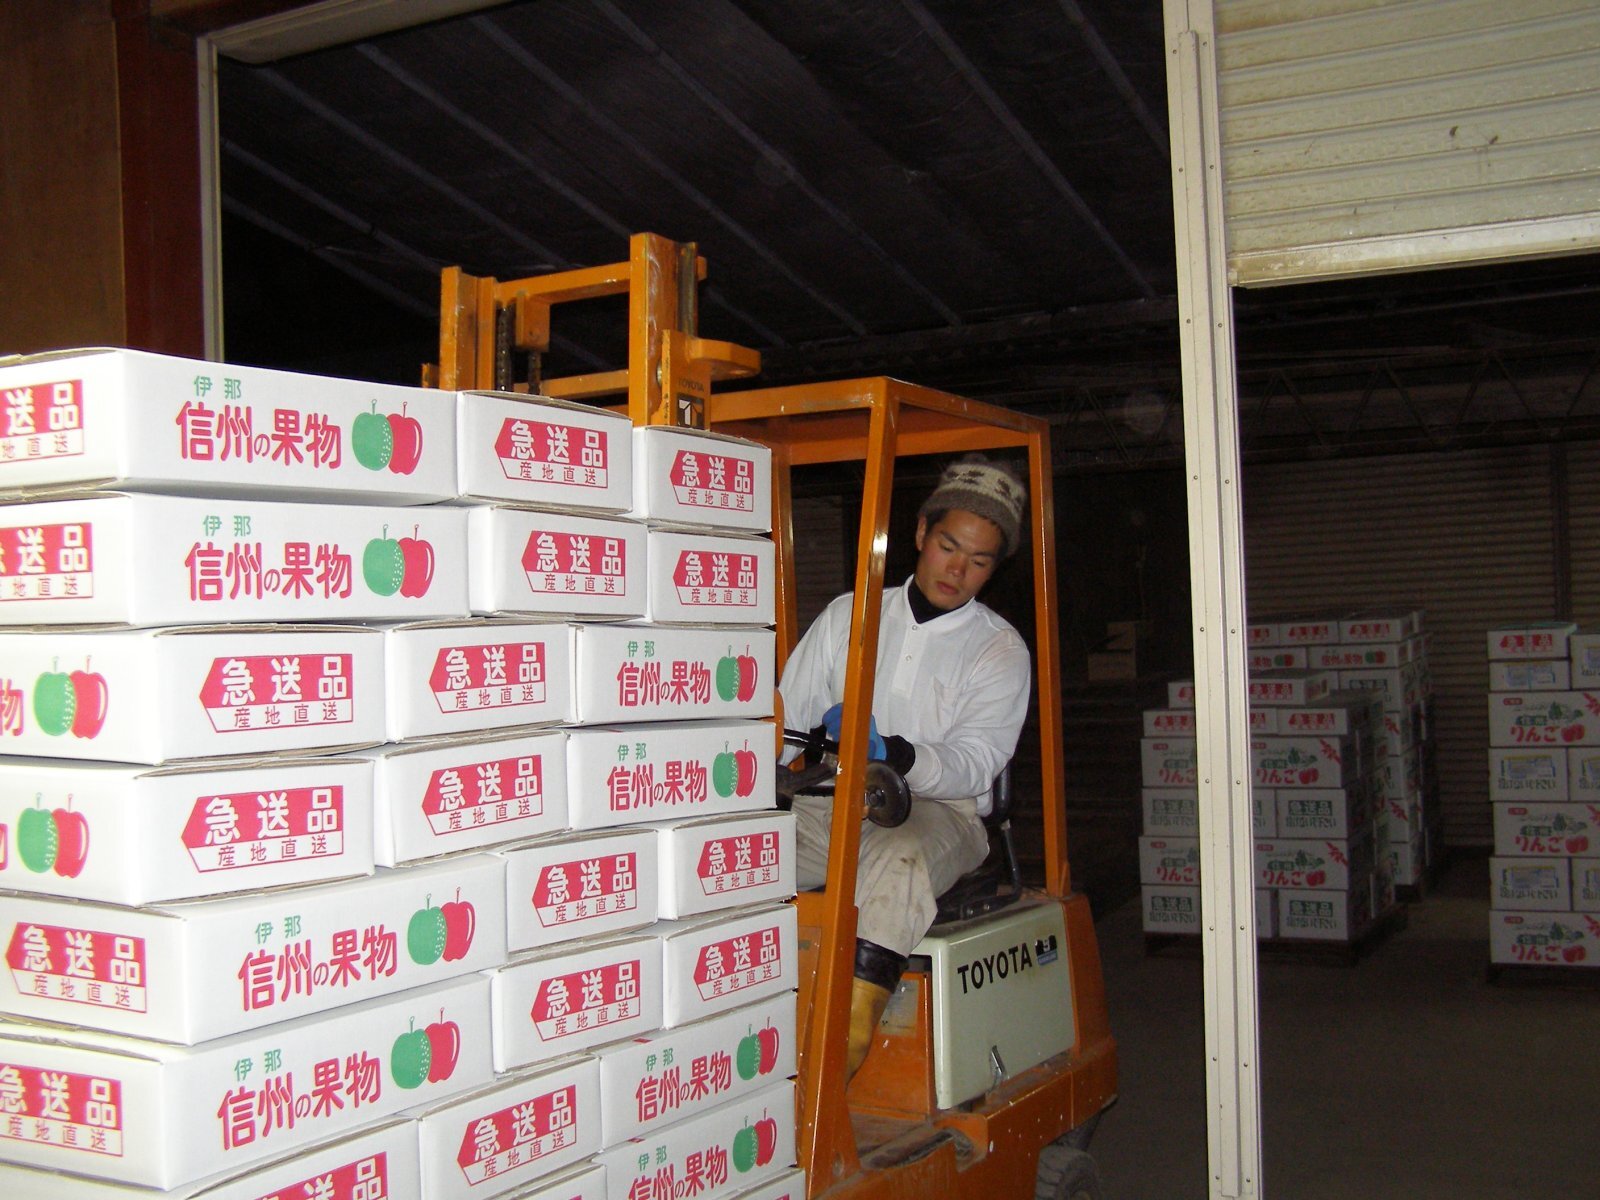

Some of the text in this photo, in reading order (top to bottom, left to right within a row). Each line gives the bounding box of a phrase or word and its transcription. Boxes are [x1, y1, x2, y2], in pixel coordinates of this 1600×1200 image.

[194, 375, 241, 400] 伊那
[176, 400, 341, 469] 信州の果物
[510, 420, 603, 468] 急送品
[520, 461, 597, 485] 産地直送
[681, 453, 751, 493] 急送品
[688, 488, 746, 508] 産地直送
[203, 514, 251, 537] 伊那
[0, 525, 89, 575] 送品
[536, 533, 622, 574] 急送品
[185, 541, 353, 601] 信州の果物
[544, 574, 615, 593] 産地直送
[685, 551, 755, 588] 急送品
[690, 588, 749, 605] 産地直送
[627, 640, 655, 657] 伊那
[222, 655, 347, 706] 急送品
[445, 644, 541, 691] 急送品
[617, 660, 711, 707] 信州の果物
[455, 684, 534, 709] 産地直送
[234, 702, 339, 729] 産地直送
[617, 743, 647, 762] 伊那
[439, 757, 538, 812] 急送品
[606, 760, 708, 811] 信州の果物
[1256, 768, 1298, 785] りんご
[205, 788, 338, 845] 急送品
[449, 800, 531, 829] 産地直送
[218, 835, 328, 867] 産地直送
[708, 833, 777, 876] 急送品
[547, 855, 633, 904] 急送品
[715, 867, 771, 891] 産地直送
[1263, 869, 1307, 887] りんご
[555, 893, 627, 922] 産地直送
[255, 915, 302, 944] 伊那
[23, 925, 141, 986] 急送品
[237, 923, 398, 1012] 信州の果物
[704, 929, 778, 982] 急送品
[957, 942, 1033, 994] TOYOTA
[34, 974, 130, 1008] 産地直送
[546, 963, 637, 1019] 急送品
[713, 964, 772, 996] 産地直送
[554, 1001, 630, 1035] 産地直送
[234, 1048, 282, 1081] 伊那
[646, 1047, 674, 1072] 伊那
[216, 1050, 381, 1150] 信州の果物
[635, 1050, 732, 1123] 信州の果物
[8, 1114, 106, 1151] 産地直送
[474, 1090, 573, 1161] 急送品
[483, 1130, 565, 1177] 産地直送
[638, 1145, 667, 1172] 伊那
